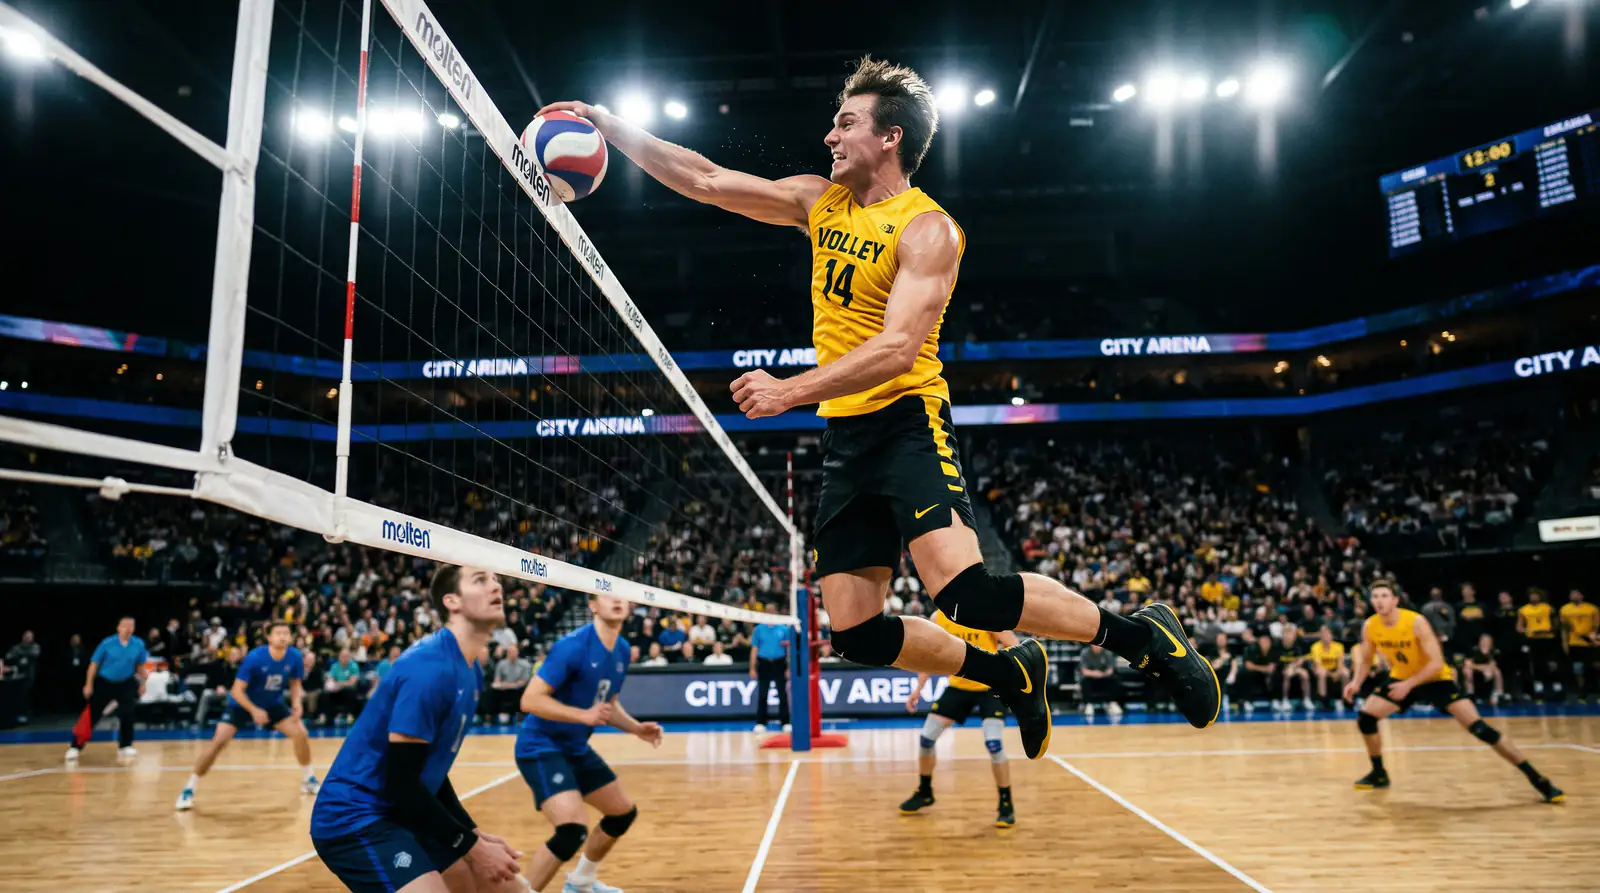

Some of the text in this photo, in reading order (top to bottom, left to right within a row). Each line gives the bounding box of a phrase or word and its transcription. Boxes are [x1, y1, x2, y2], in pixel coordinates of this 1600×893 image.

[415, 11, 472, 100] molten
[1464, 142, 1511, 168] 12:00
[512, 143, 550, 206] molten
[818, 227, 886, 264] VOLLEY
[822, 258, 856, 307] 14
[733, 347, 817, 367] CITY ARE
[1100, 336, 1211, 356] CITY ARENA
[422, 358, 529, 379] CITY ARENA
[1514, 345, 1600, 377] CITY A
[535, 416, 645, 437] CITY ARENA
[382, 519, 431, 549] molten
[685, 679, 758, 707] CITY
